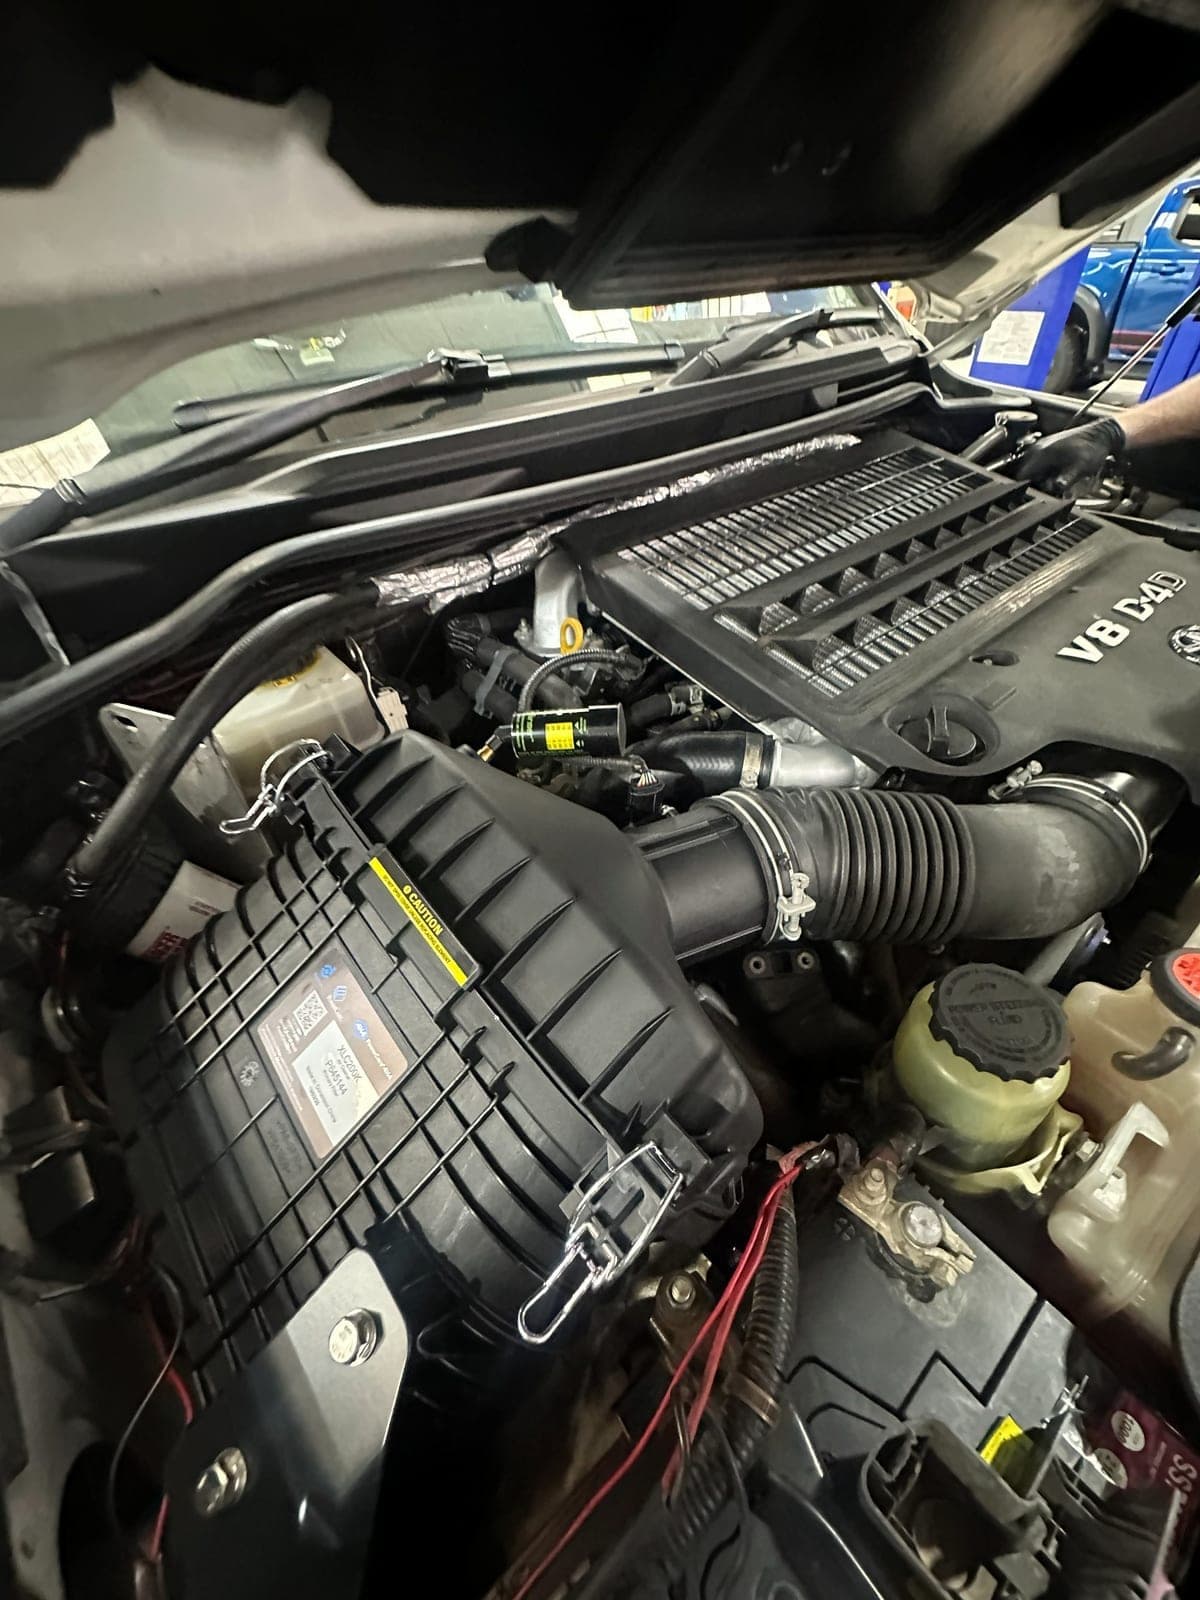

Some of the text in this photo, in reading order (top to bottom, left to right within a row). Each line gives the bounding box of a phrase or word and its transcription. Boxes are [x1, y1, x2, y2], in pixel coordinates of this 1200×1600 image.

[1055, 618, 1131, 664] V8
[407, 890, 444, 936] CAUTION
[323, 1056, 350, 1097] P645144
[1119, 1413, 1134, 1443] 1000
